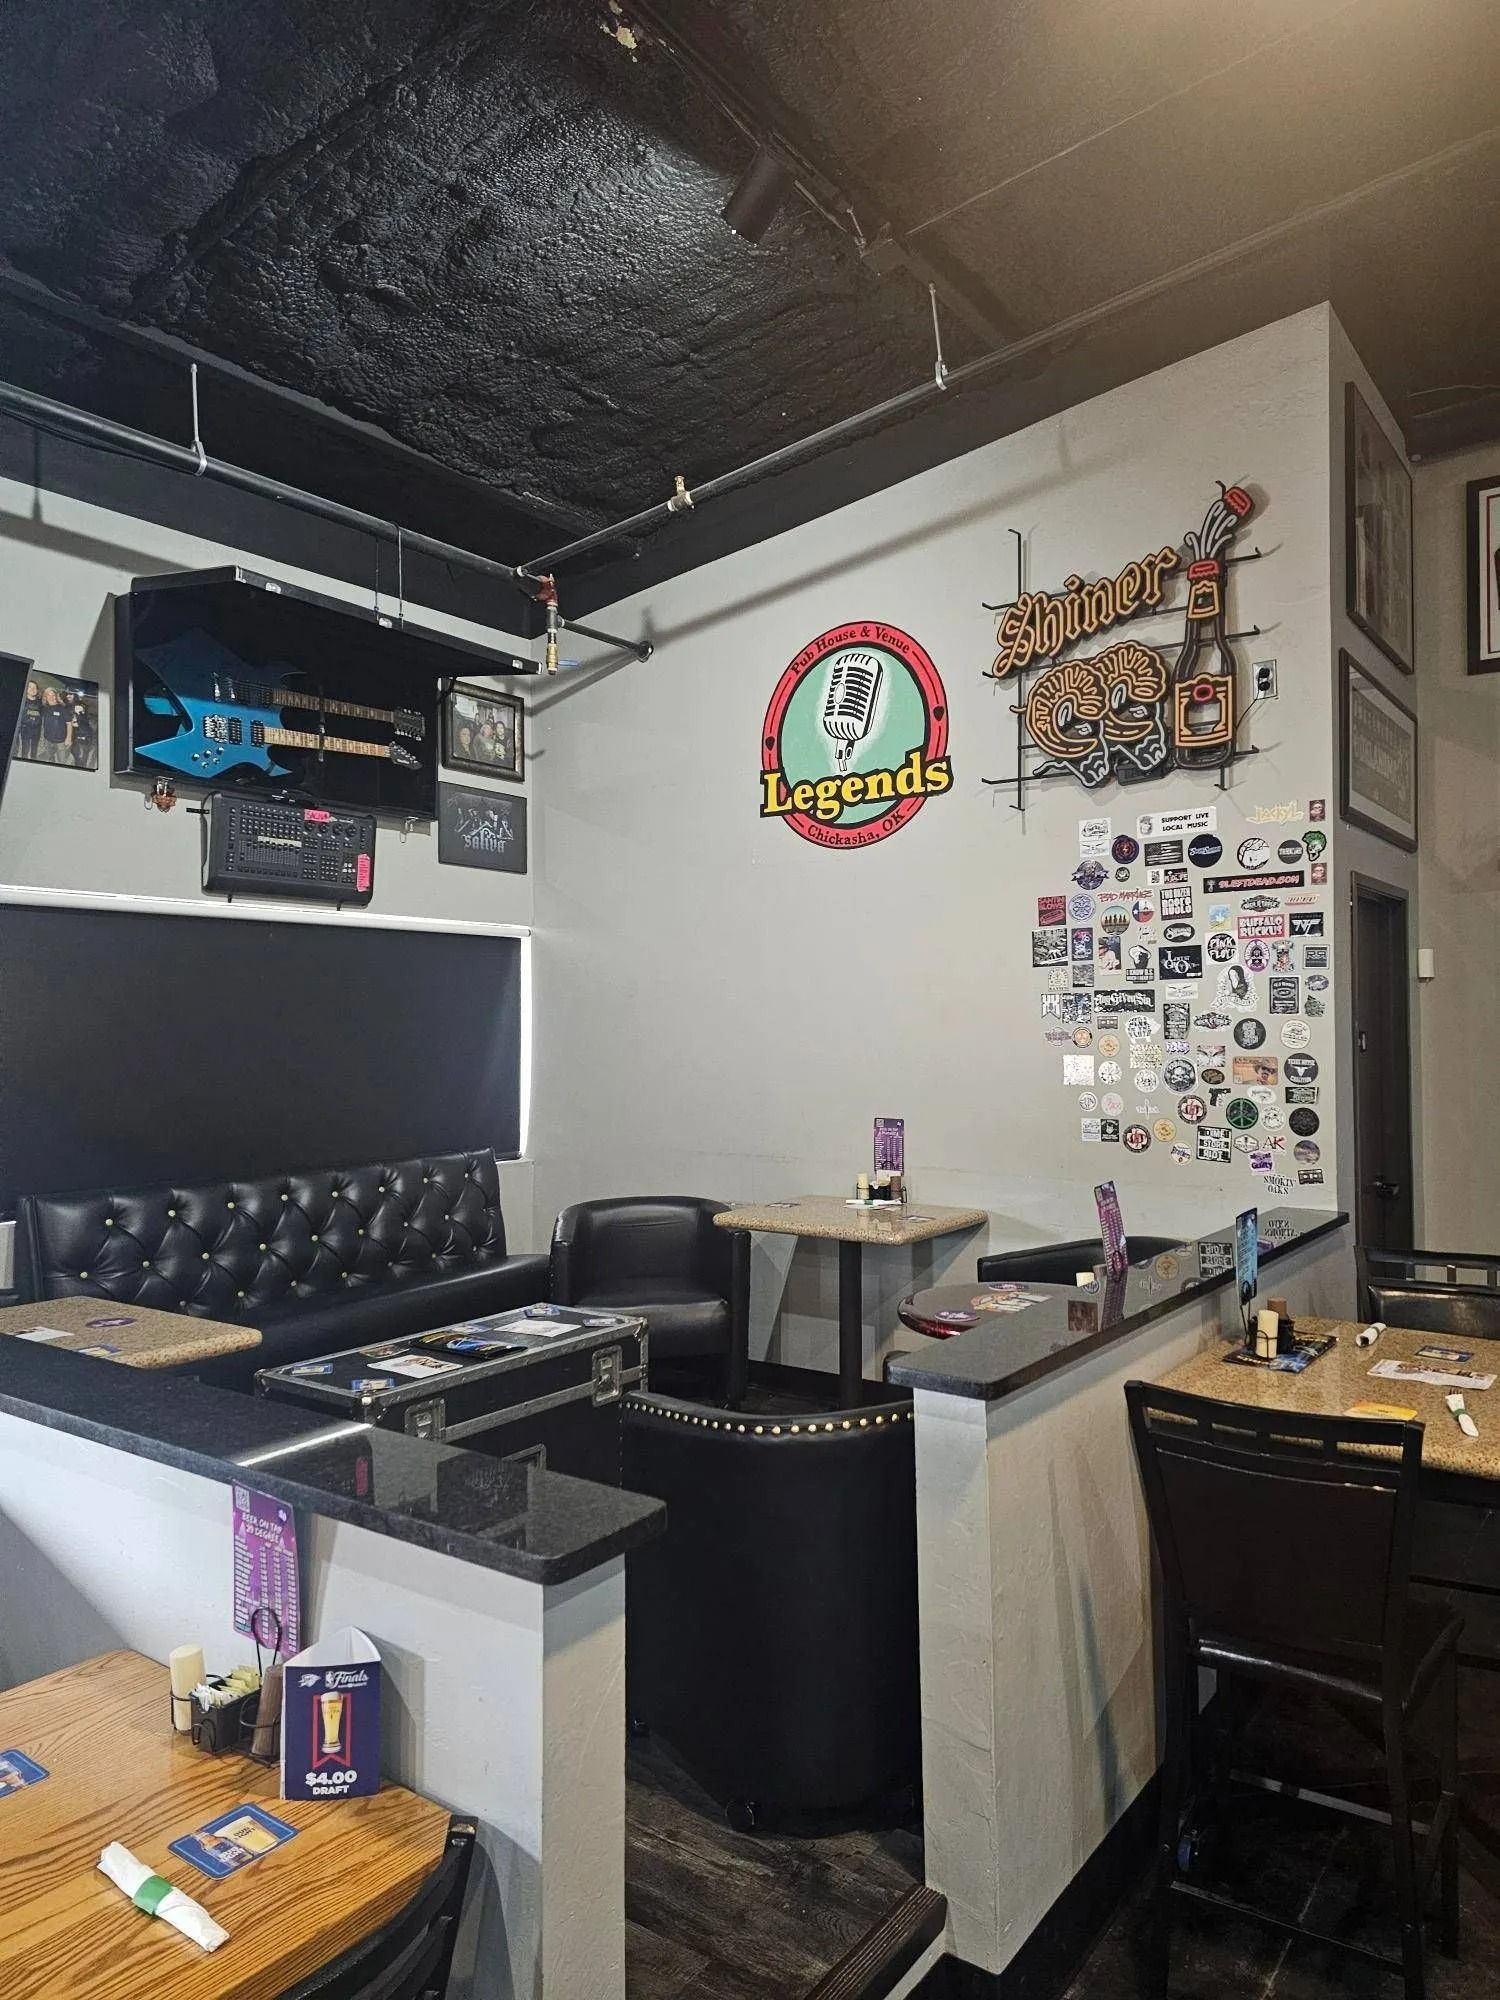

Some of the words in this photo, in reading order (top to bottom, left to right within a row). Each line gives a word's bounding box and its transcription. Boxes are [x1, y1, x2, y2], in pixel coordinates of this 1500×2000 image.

[992, 546, 1181, 678] Shiner
[791, 649, 814, 675] Pub
[815, 629, 857, 654] House
[860, 626, 871, 638] &
[875, 626, 910, 654] Venue
[761, 751, 951, 821] Legends
[1161, 814, 1191, 823] SUPPORT
[1195, 812, 1209, 820] LIVE
[807, 824, 881, 846] Chickasha,
[882, 810, 905, 832] OK
[1162, 822, 1183, 831] LOCAL
[1187, 821, 1208, 829] MUSIC
[1239, 916, 1283, 928] BUFFALO
[1239, 926, 1283, 938] RUCKUS
[1209, 937, 1233, 950] PINK
[1203, 1140, 1225, 1149] STORE
[1267, 1185, 1289, 1195] OAKS
[330, 1669, 369, 1689] Finals
[305, 1770, 357, 1786] $4.00
[313, 1785, 350, 1795] DRAFT
